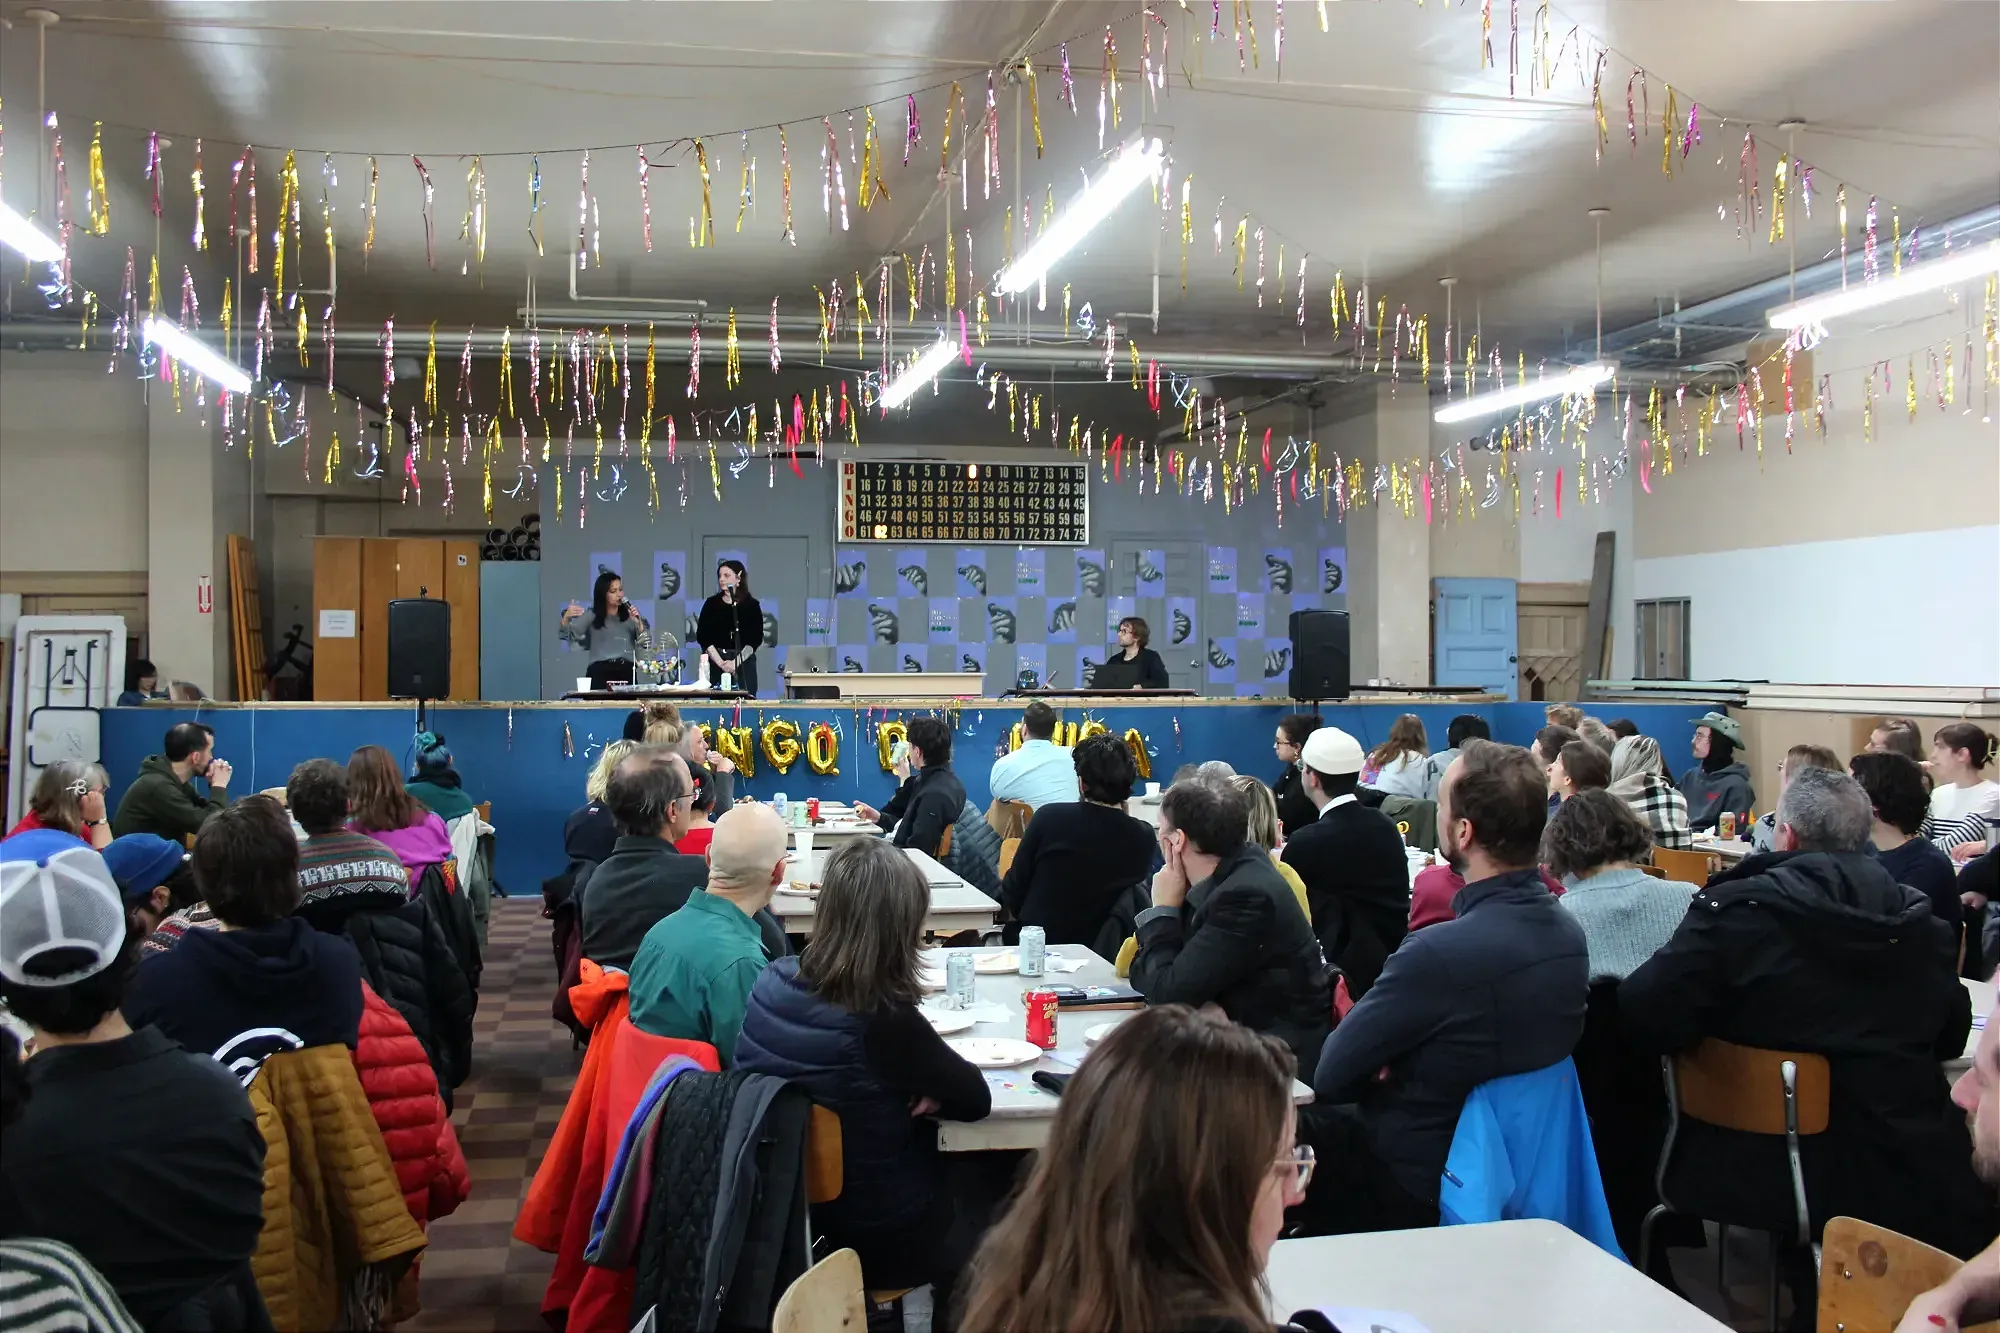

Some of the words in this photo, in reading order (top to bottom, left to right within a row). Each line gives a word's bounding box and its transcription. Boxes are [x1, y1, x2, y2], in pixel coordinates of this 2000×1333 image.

[999, 466, 1009, 478] 10
[1015, 466, 1023, 478] 11
[1029, 467, 1039, 479] 12
[1044, 467, 1054, 480] 13
[1059, 467, 1069, 479] 14
[1075, 467, 1084, 480] 15
[860, 478, 871, 491] 16
[876, 479, 886, 491] 17
[892, 479, 902, 492] 18
[907, 479, 917, 492] 19
[921, 480, 933, 492] 20
[937, 480, 948, 493] 21
[952, 480, 964, 493] 22
[967, 480, 979, 493] 23
[982, 481, 994, 493] 24
[997, 481, 1009, 493] 25
[1013, 481, 1024, 494] 26
[1028, 481, 1040, 494] 27
[1043, 481, 1055, 494] 28
[1058, 482, 1070, 495] 29
[1073, 482, 1085, 495] 30
[860, 494, 871, 507] 31
[875, 494, 887, 507] 32
[891, 494, 903, 507] 33
[906, 495, 918, 508] 34
[921, 495, 933, 508] 35
[937, 495, 949, 508] 36
[952, 495, 964, 508] 37
[967, 496, 979, 508] 38
[983, 496, 994, 509] 39
[998, 496, 1010, 509] 40
[1013, 497, 1024, 508] 41
[1028, 497, 1040, 509] 42
[1043, 497, 1055, 510] 43
[1058, 497, 1070, 510] 44
[1073, 497, 1085, 510] 45
[859, 509, 872, 522] 46
[875, 510, 887, 523] 47
[891, 510, 903, 523] 48
[906, 510, 918, 523] 49
[921, 510, 933, 524] 50
[938, 511, 948, 523] 51
[952, 511, 964, 523] 52
[968, 511, 979, 524] 53
[983, 511, 994, 524] 54
[998, 511, 1010, 524] 55
[1013, 512, 1025, 524] 56
[1028, 512, 1040, 524] 57
[1043, 512, 1055, 525] 58
[1058, 512, 1070, 525] 59
[1073, 513, 1085, 525] 60
[860, 525, 871, 538] 61
[891, 525, 903, 538] 63
[906, 526, 918, 538] 64
[921, 525, 933, 538] 65
[937, 526, 949, 538] 66
[952, 526, 964, 539] 67
[967, 526, 979, 539] 68
[983, 526, 995, 539] 69
[998, 527, 1010, 539] 70
[1014, 527, 1024, 539] 71
[1028, 527, 1040, 540] 72
[1043, 527, 1055, 540] 73
[1058, 528, 1070, 540] 74
[1073, 528, 1085, 540] 75
